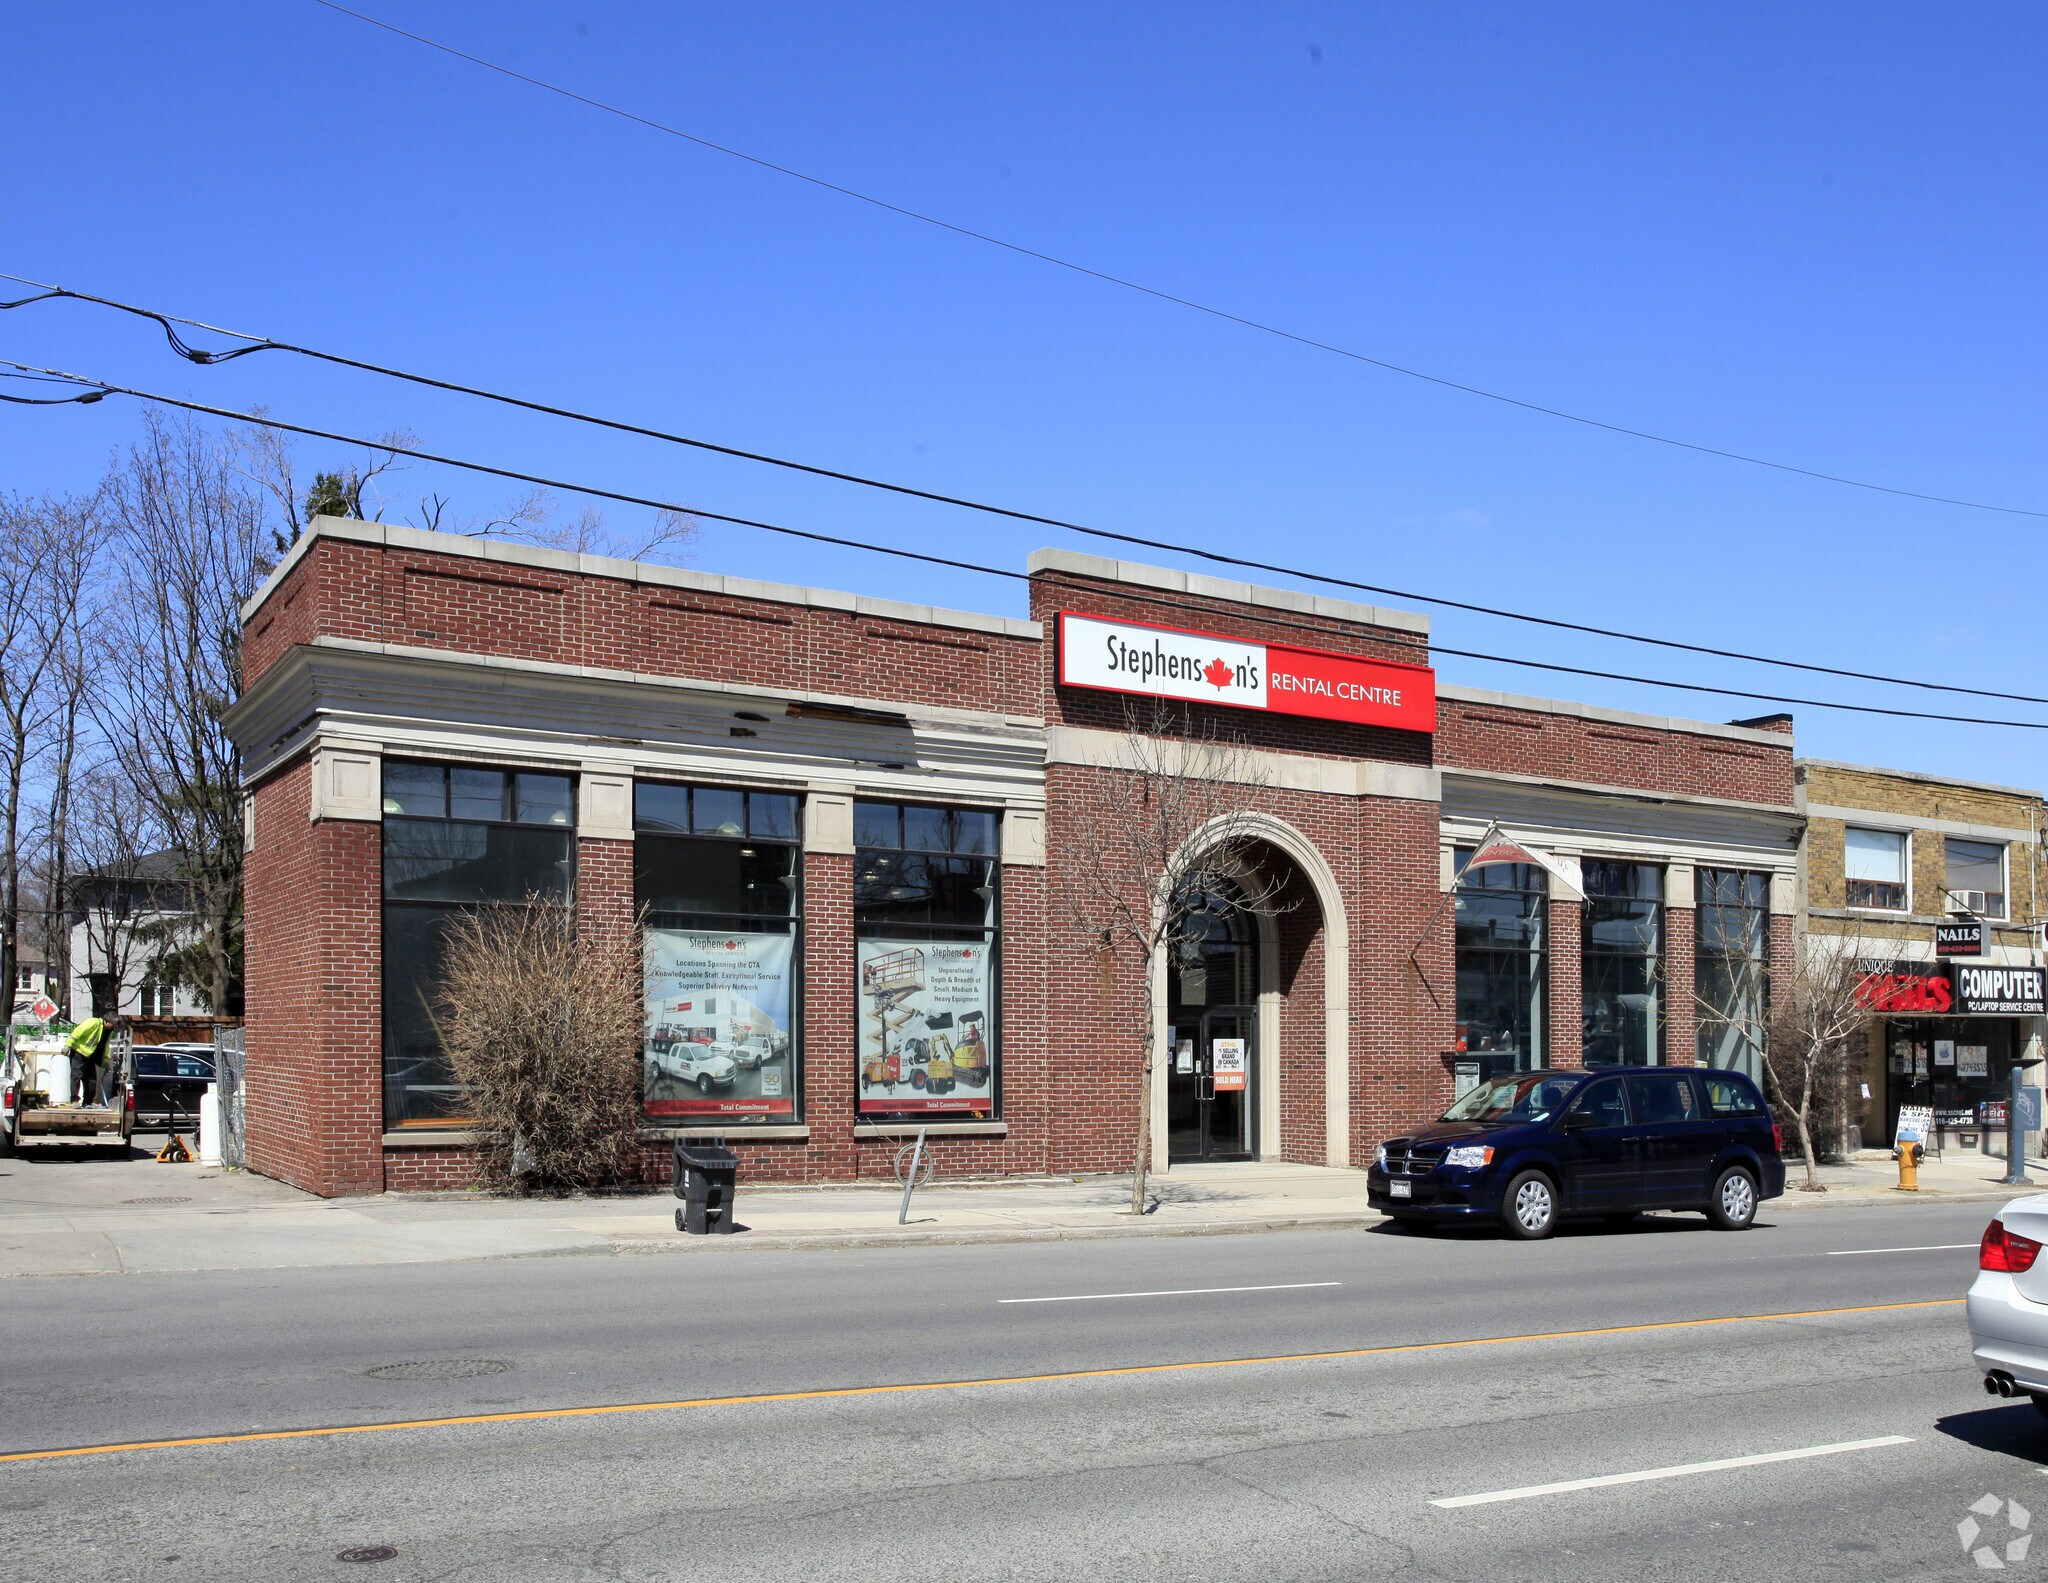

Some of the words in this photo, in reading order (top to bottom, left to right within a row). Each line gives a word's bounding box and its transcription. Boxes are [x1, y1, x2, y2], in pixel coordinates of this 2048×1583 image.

[1272, 672, 1334, 697] RENTAL
[1336, 682, 1402, 706] CENTRE
[1937, 928, 1981, 941] NAILS
[676, 959, 706, 967] Locations
[708, 960, 736, 969] Spanning
[738, 960, 747, 968] the
[748, 961, 760, 969] GTA
[1858, 959, 1894, 973] UNIQUE
[655, 970, 703, 979] Knowledgeable
[721, 972, 757, 981] Exceptional
[954, 976, 974, 984] Breadth
[678, 982, 705, 991] Superior
[705, 983, 731, 991] Delivery
[732, 983, 759, 991] Network
[1960, 968, 2044, 999] COMPUTER
[934, 995, 951, 1003] Heavy
[951, 995, 979, 1003] Equipment
[1968, 1001, 1999, 1011] PC/LAPTOP
[1999, 1002, 2022, 1012] SERVICE
[2023, 1002, 2044, 1012] CENTRE
[1215, 1076, 1229, 1084] SOLD
[1230, 1076, 1243, 1084] HERE
[720, 1103, 734, 1111] Total
[735, 1103, 770, 1111] Commitment
[1982, 1110, 2006, 1118] RENT
